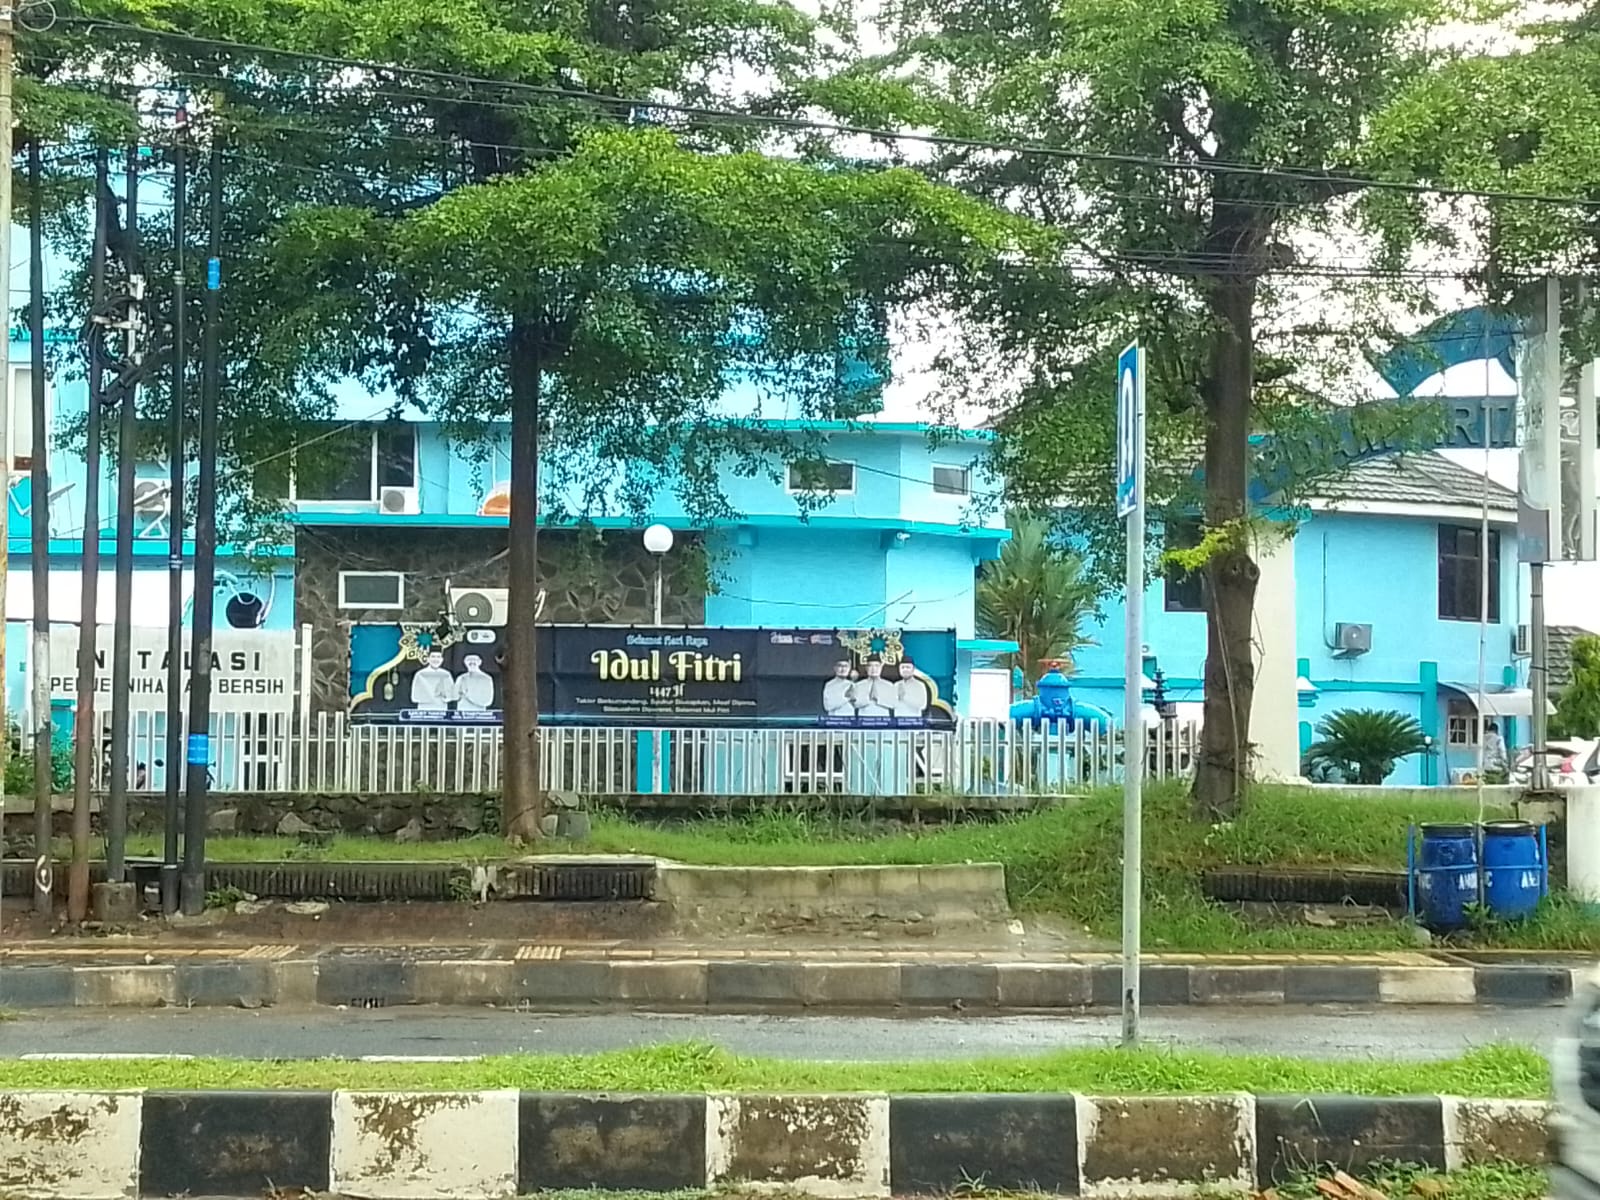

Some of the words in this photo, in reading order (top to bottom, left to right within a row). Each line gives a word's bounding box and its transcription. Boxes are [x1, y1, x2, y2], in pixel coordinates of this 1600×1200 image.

[590, 649, 660, 681] Idul
[668, 651, 741, 682] Fitri
[218, 678, 283, 694] BERSIH
